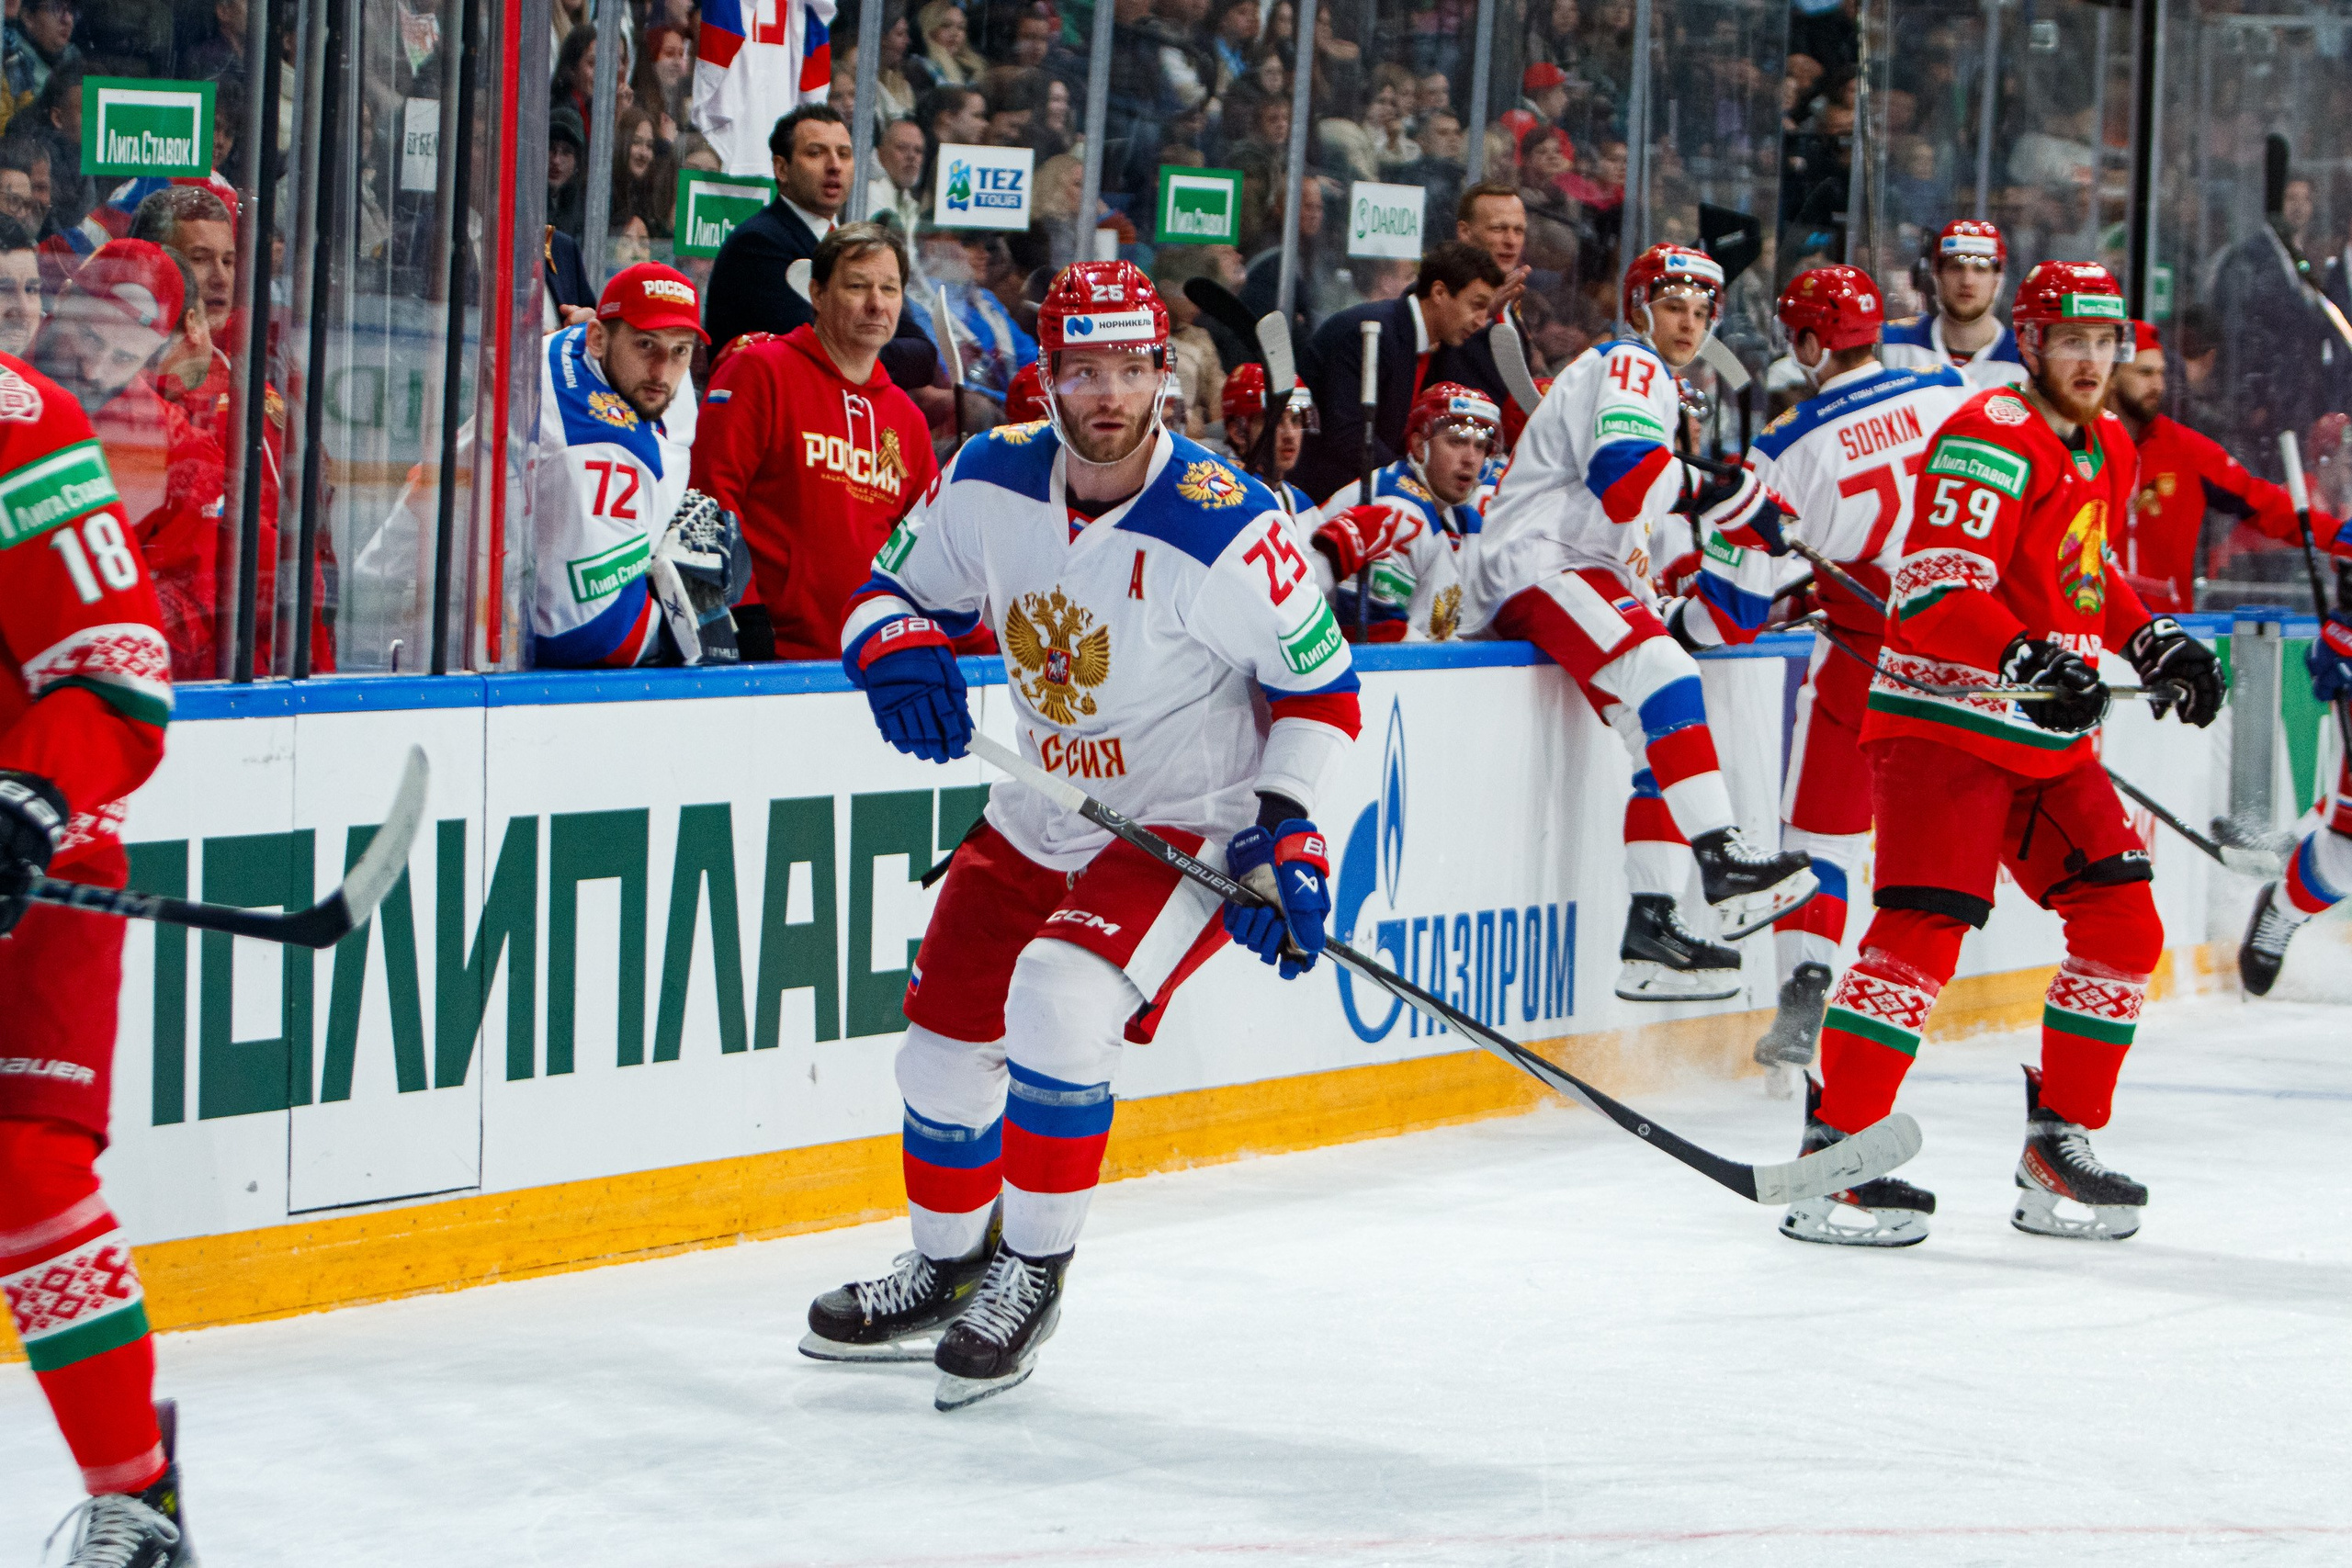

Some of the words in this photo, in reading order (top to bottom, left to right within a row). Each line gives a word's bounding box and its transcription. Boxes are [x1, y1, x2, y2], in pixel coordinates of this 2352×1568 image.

[976, 166, 1024, 191] TEZ
[978, 193, 1019, 208] TOUR
[1091, 283, 1125, 303] 25
[1098, 319, 1153, 330] НОРНИКЕЛЬ
[1609, 354, 1657, 400] 43
[1838, 404, 1923, 461] SORKIN
[584, 460, 639, 521] 72
[1928, 478, 2001, 541] 59
[49, 511, 139, 606] 18
[1242, 519, 1308, 607] 25
[1298, 630, 1332, 671] ЛИГА
[1174, 855, 1238, 896] BAUER
[1046, 908, 1122, 937] CCM
[1410, 900, 1577, 1041] ГАЗПРОМ
[2024, 1151, 2056, 1188] CCM
